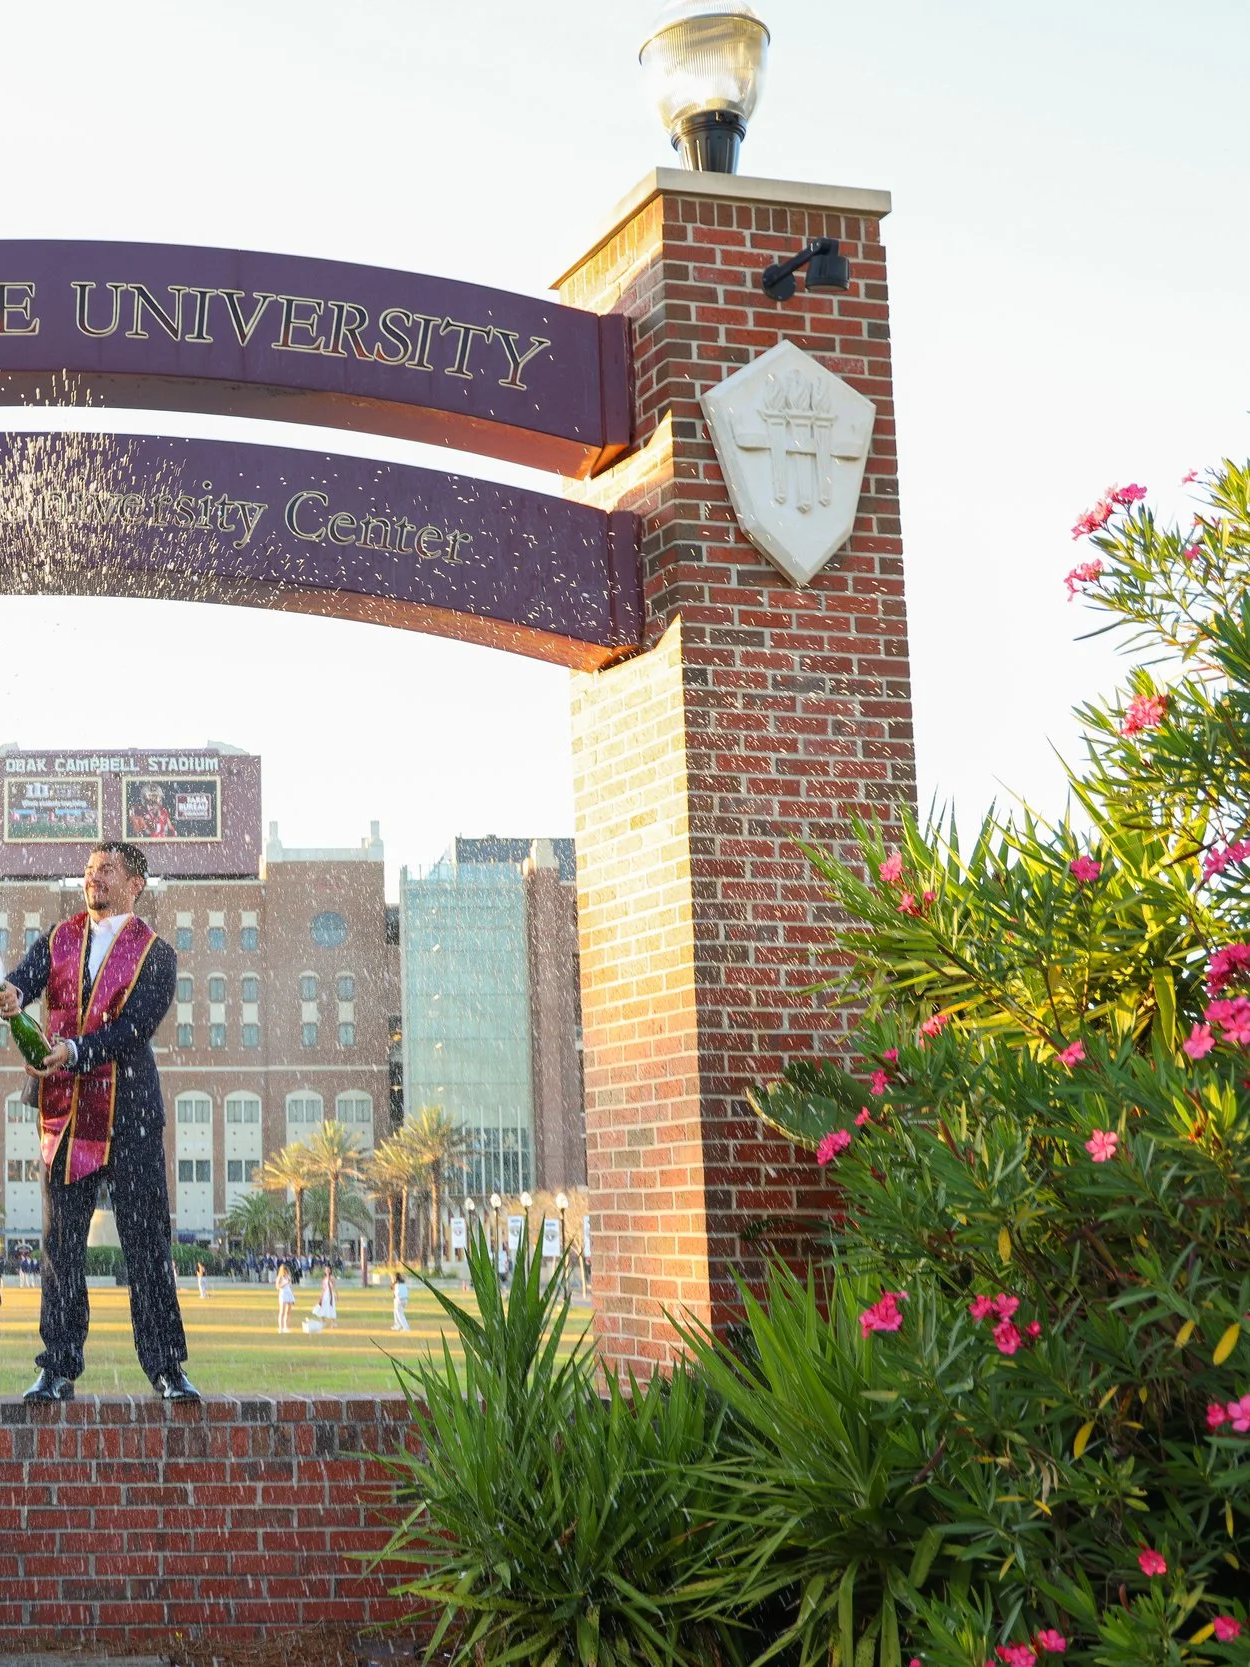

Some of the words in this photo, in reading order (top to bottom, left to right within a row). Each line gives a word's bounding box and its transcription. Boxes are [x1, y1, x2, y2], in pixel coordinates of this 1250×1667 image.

[71, 280, 551, 390] UNIVERSITY
[284, 490, 473, 565] Center
[5, 758, 47, 773] DOAK
[54, 757, 139, 772] CAMPBELL
[148, 756, 219, 771] STADIUM
